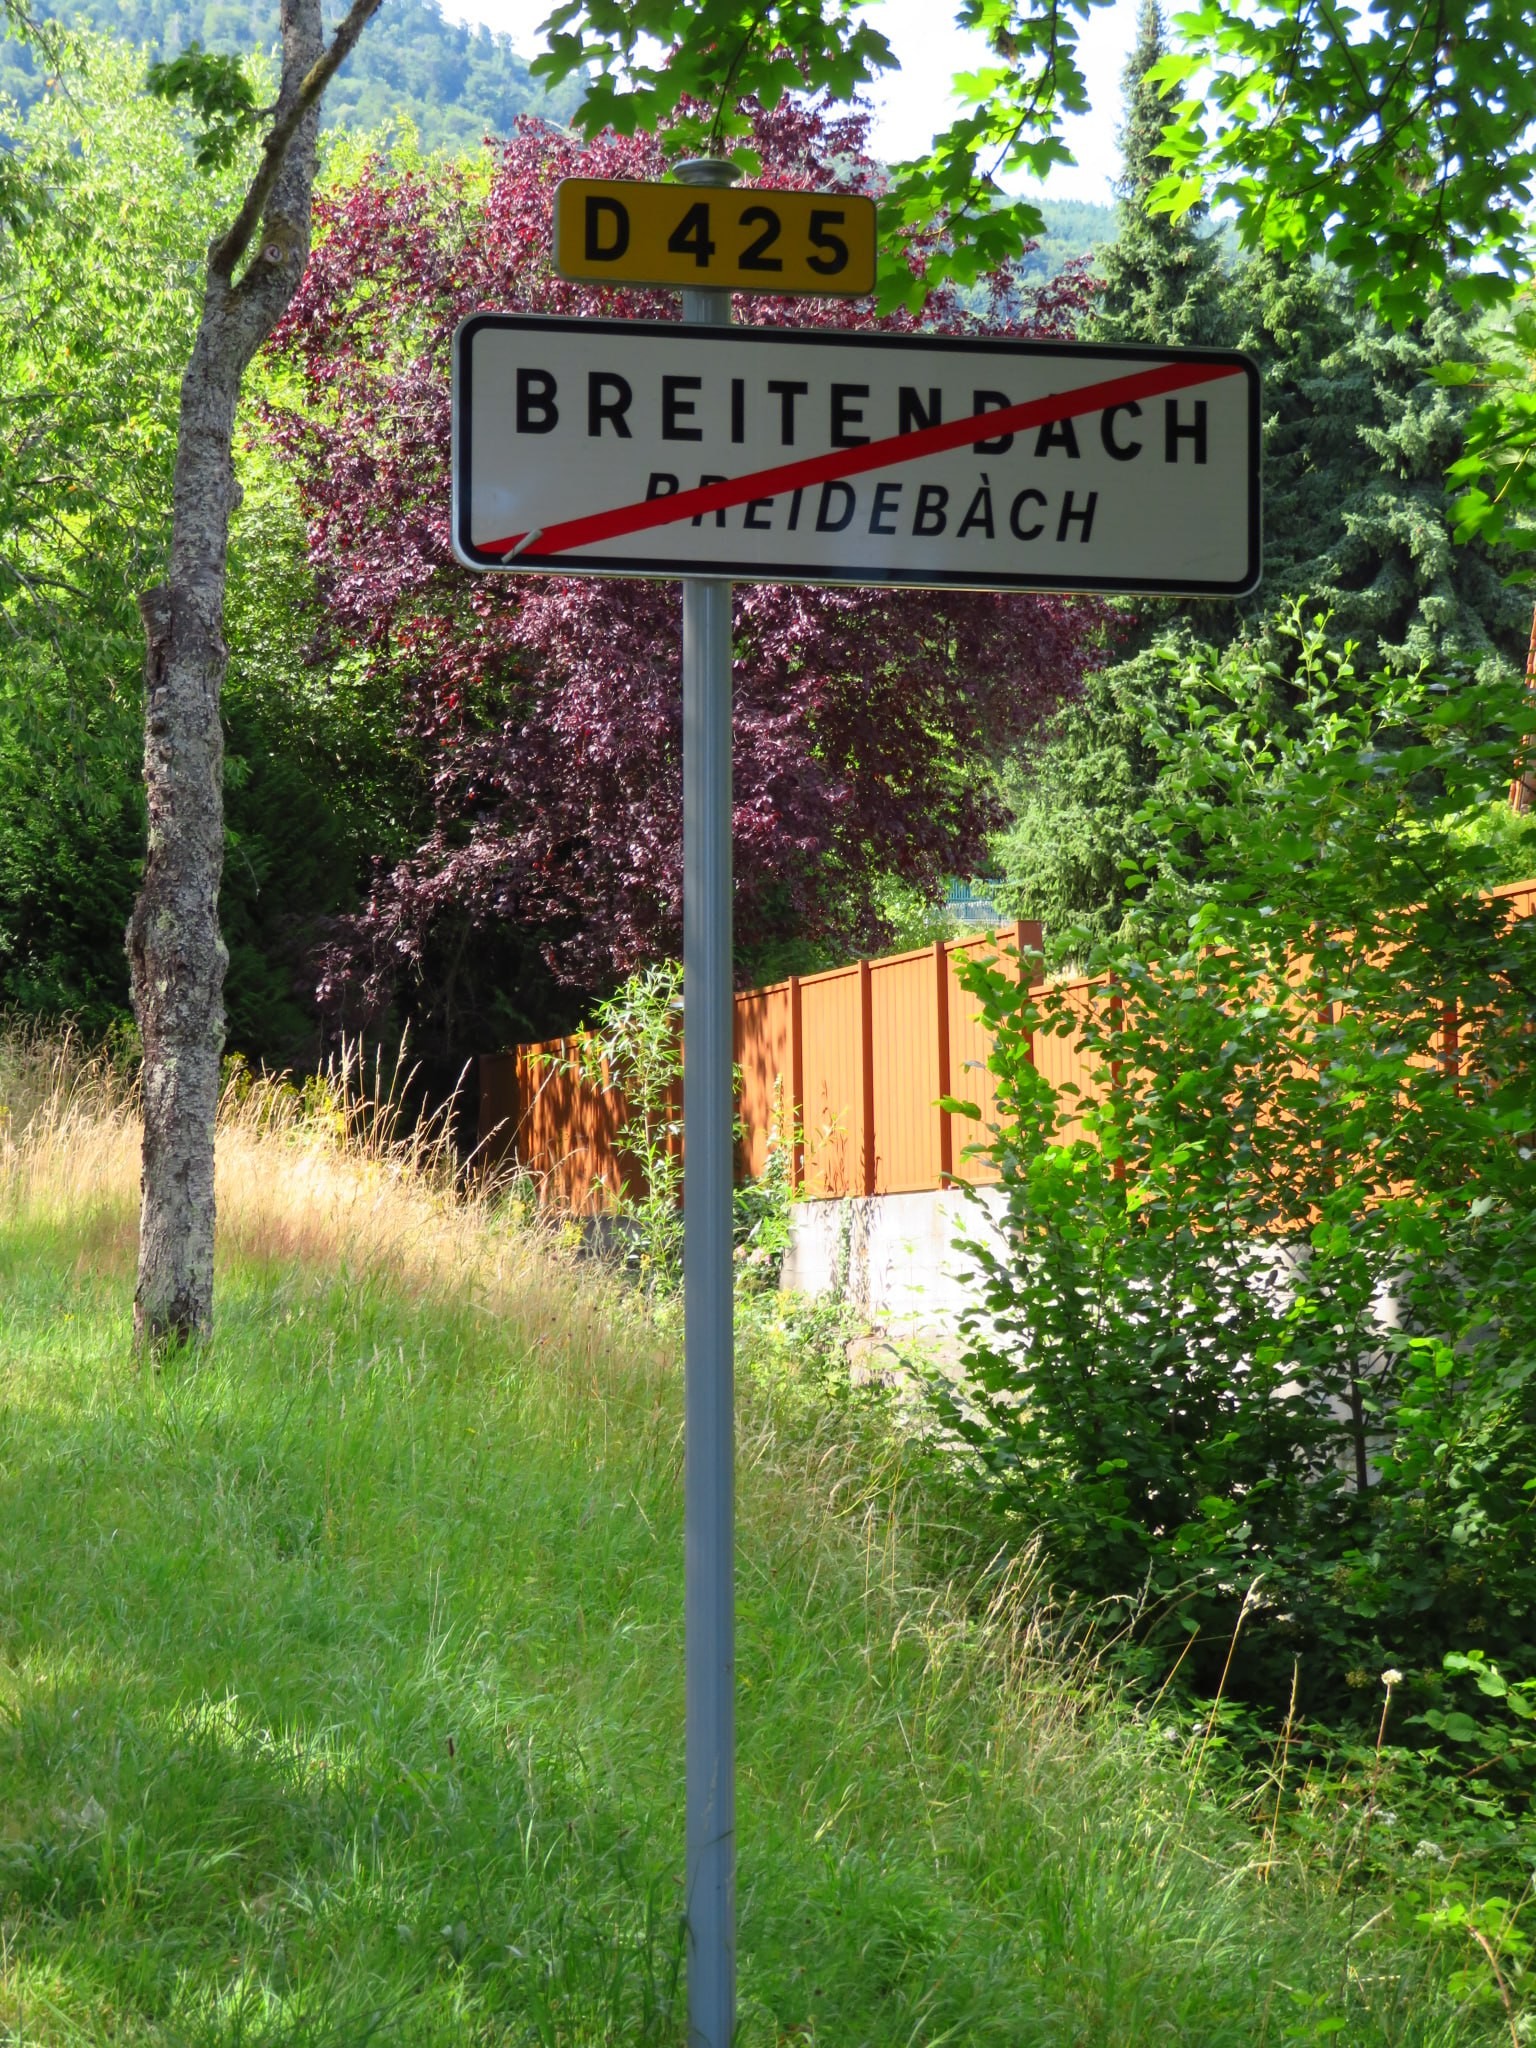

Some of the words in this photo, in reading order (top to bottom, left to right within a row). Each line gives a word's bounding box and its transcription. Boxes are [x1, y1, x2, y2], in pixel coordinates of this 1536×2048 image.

[585, 196, 630, 262] D
[668, 203, 849, 275] 425
[516, 368, 1207, 465] BREITENBACH
